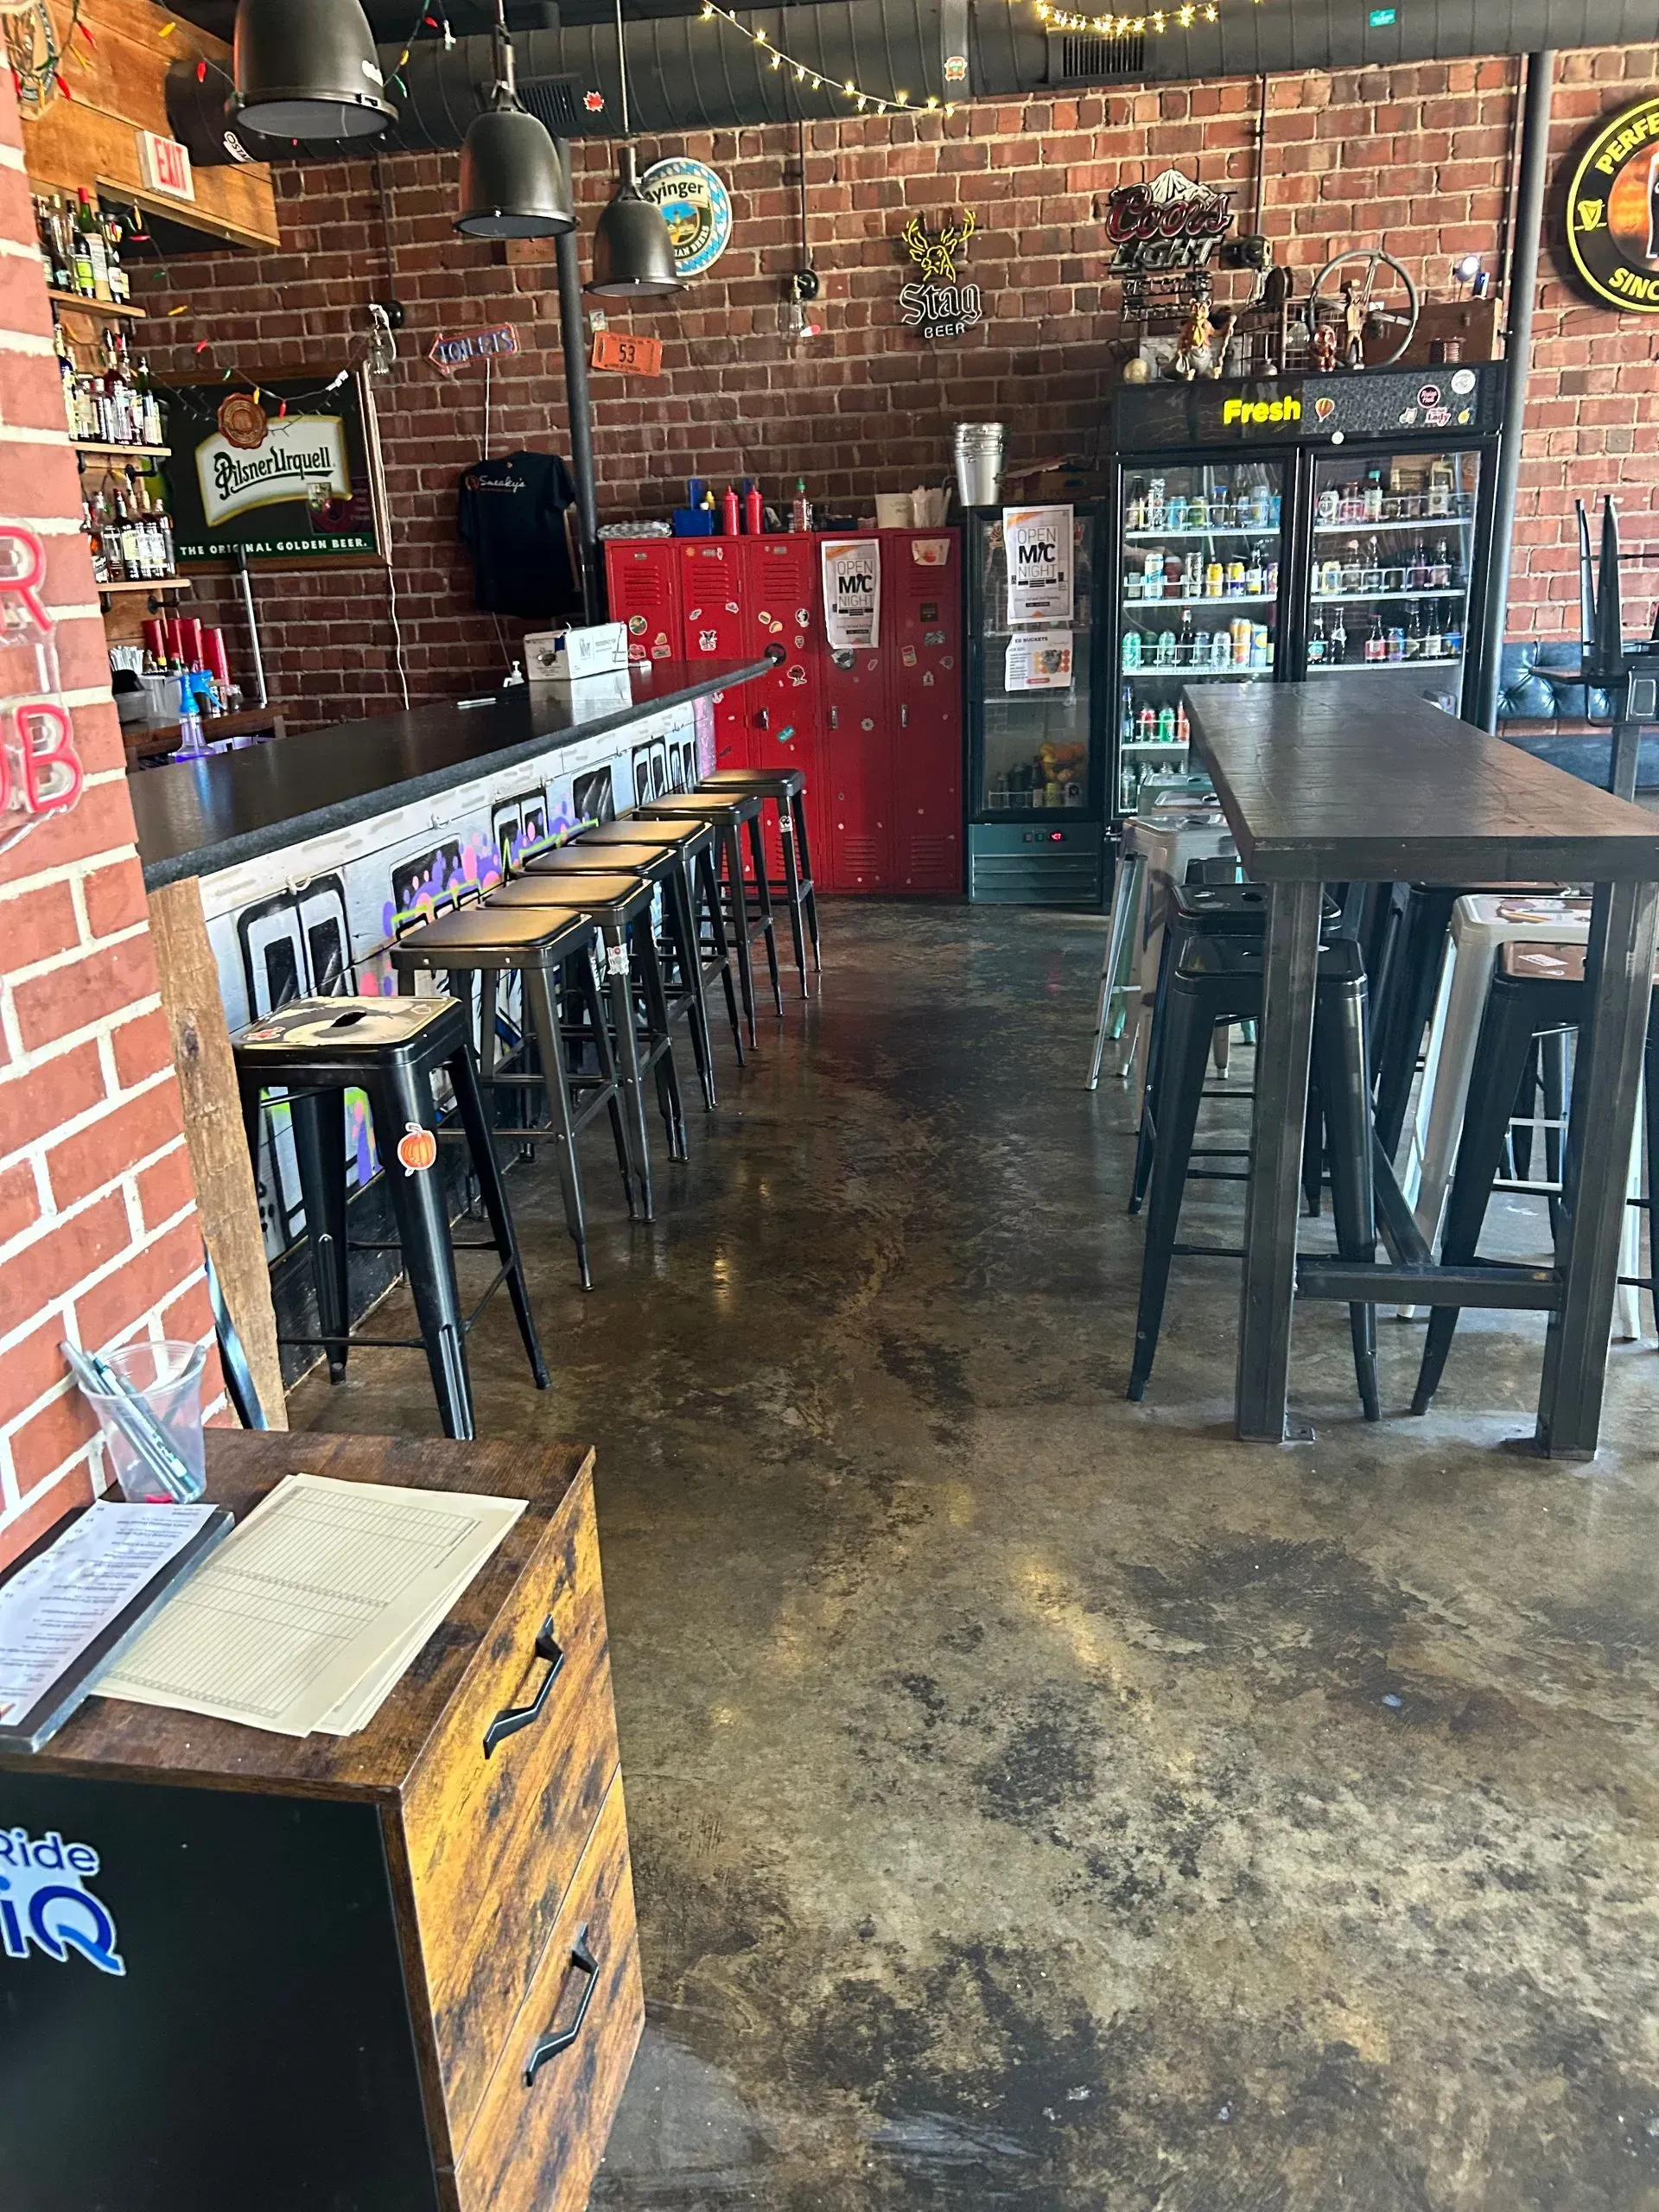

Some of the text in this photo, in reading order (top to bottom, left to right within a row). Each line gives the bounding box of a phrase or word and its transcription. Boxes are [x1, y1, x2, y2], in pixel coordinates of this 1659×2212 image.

[153, 137, 187, 192] EXIT
[1106, 184, 1234, 243] Coors
[1109, 234, 1224, 274] LIGHT
[899, 283, 982, 325] Stag
[924, 322, 965, 339] BEER
[619, 343, 635, 364] 53
[1223, 396, 1301, 424] Fresh
[213, 446, 332, 501] Pilsner Urquell
[1017, 527, 1057, 544] OPEN
[179, 537, 368, 556] THE ORIGNAL GOLDEN BEER.
[836, 560, 874, 576] OPEN
[1018, 563, 1058, 579] NIGHT
[838, 594, 874, 608] NIGHT
